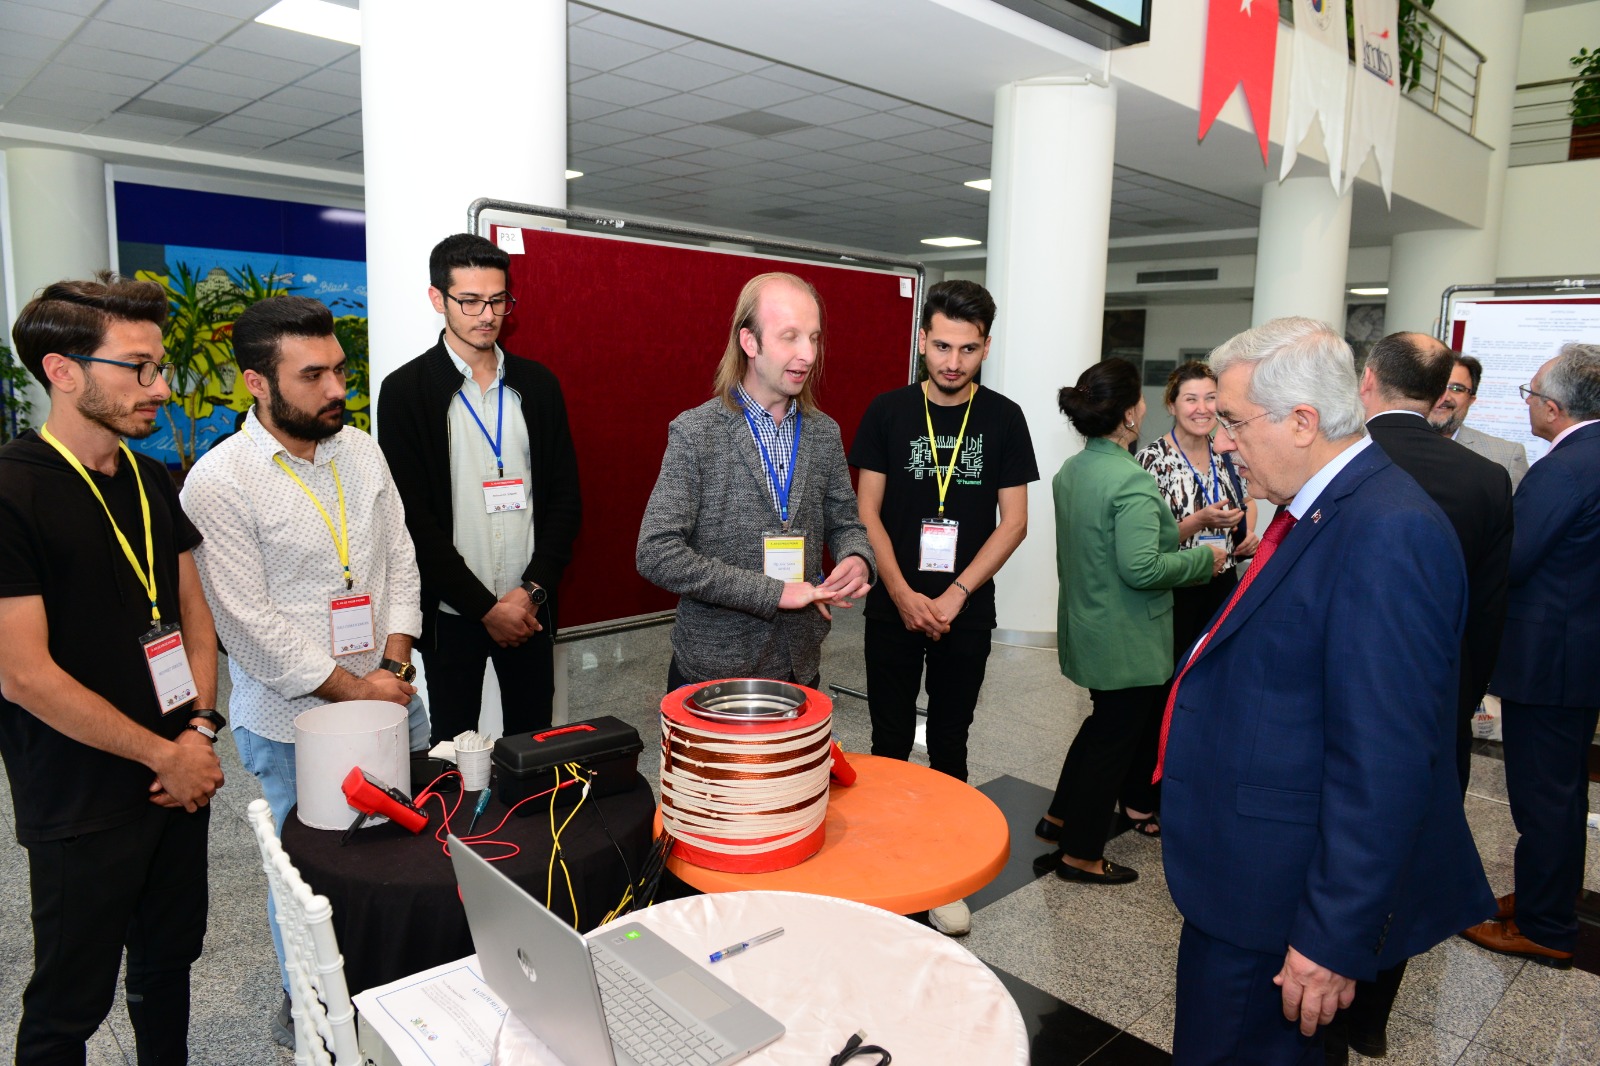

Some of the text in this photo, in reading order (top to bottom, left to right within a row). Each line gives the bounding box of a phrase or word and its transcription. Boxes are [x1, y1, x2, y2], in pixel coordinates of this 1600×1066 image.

[500, 232, 517, 242] P32
[314, 280, 351, 295] Black
[517, 947, 537, 982] hp
